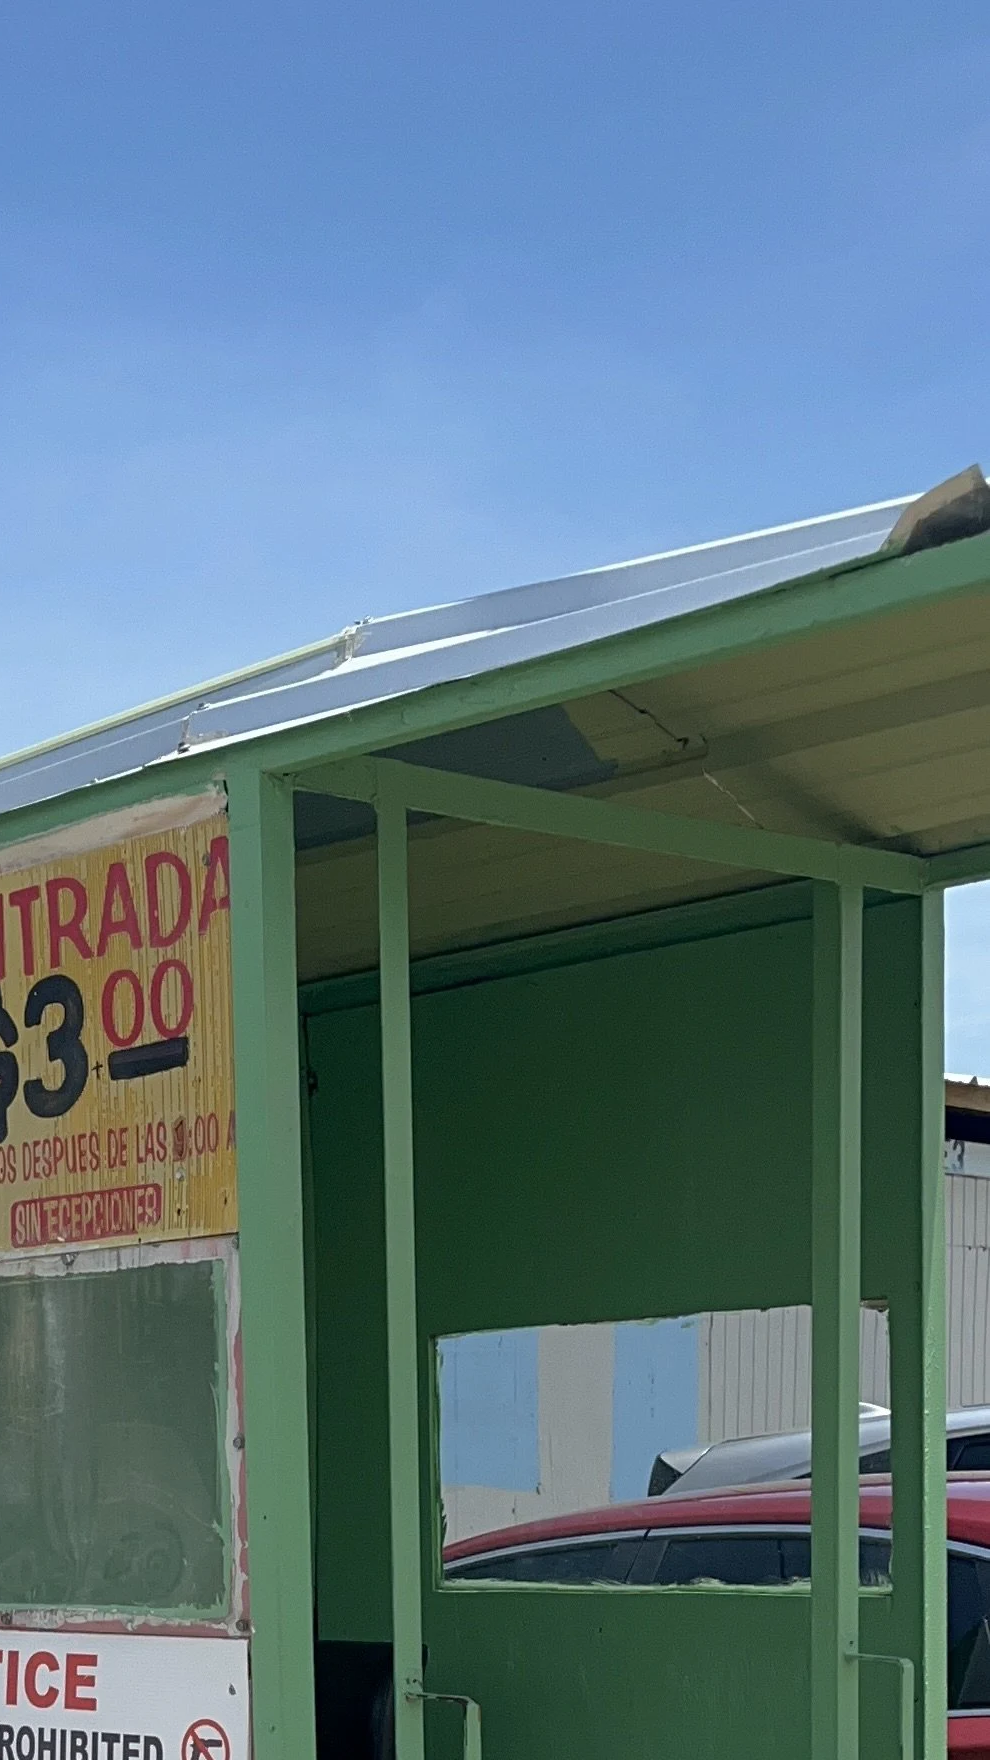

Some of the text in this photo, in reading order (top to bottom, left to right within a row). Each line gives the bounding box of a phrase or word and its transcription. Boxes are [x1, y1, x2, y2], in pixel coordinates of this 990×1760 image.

[22, 1132, 100, 1182] DESPUES
[107, 1127, 128, 1169] DE
[136, 1120, 167, 1163] LAS
[15, 1202, 41, 1245] SIN
